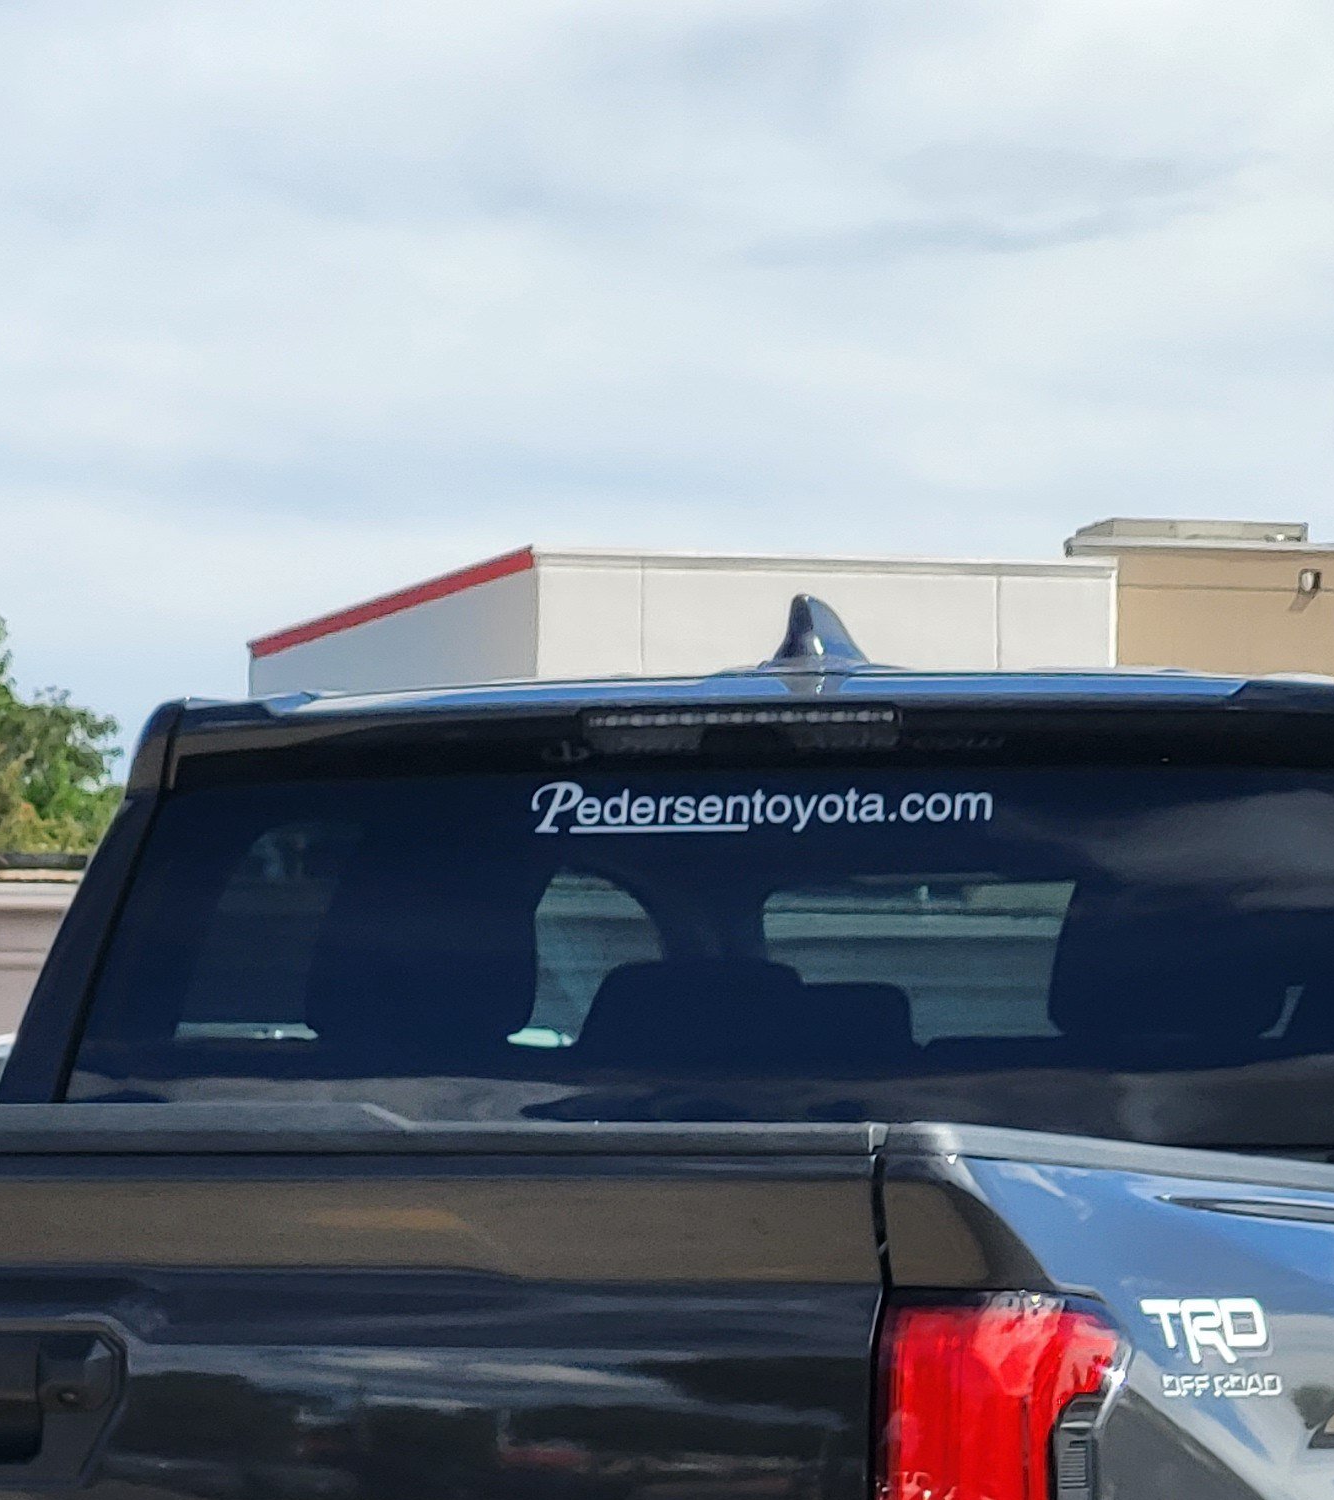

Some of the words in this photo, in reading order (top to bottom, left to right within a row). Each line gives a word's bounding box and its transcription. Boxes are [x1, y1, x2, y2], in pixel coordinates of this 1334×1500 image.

[531, 780, 994, 834] Pedersentoyota.com
[1139, 1297, 1268, 1365] TRD
[1162, 1373, 1211, 1398] OFF
[1212, 1372, 1283, 1398] ROAD
